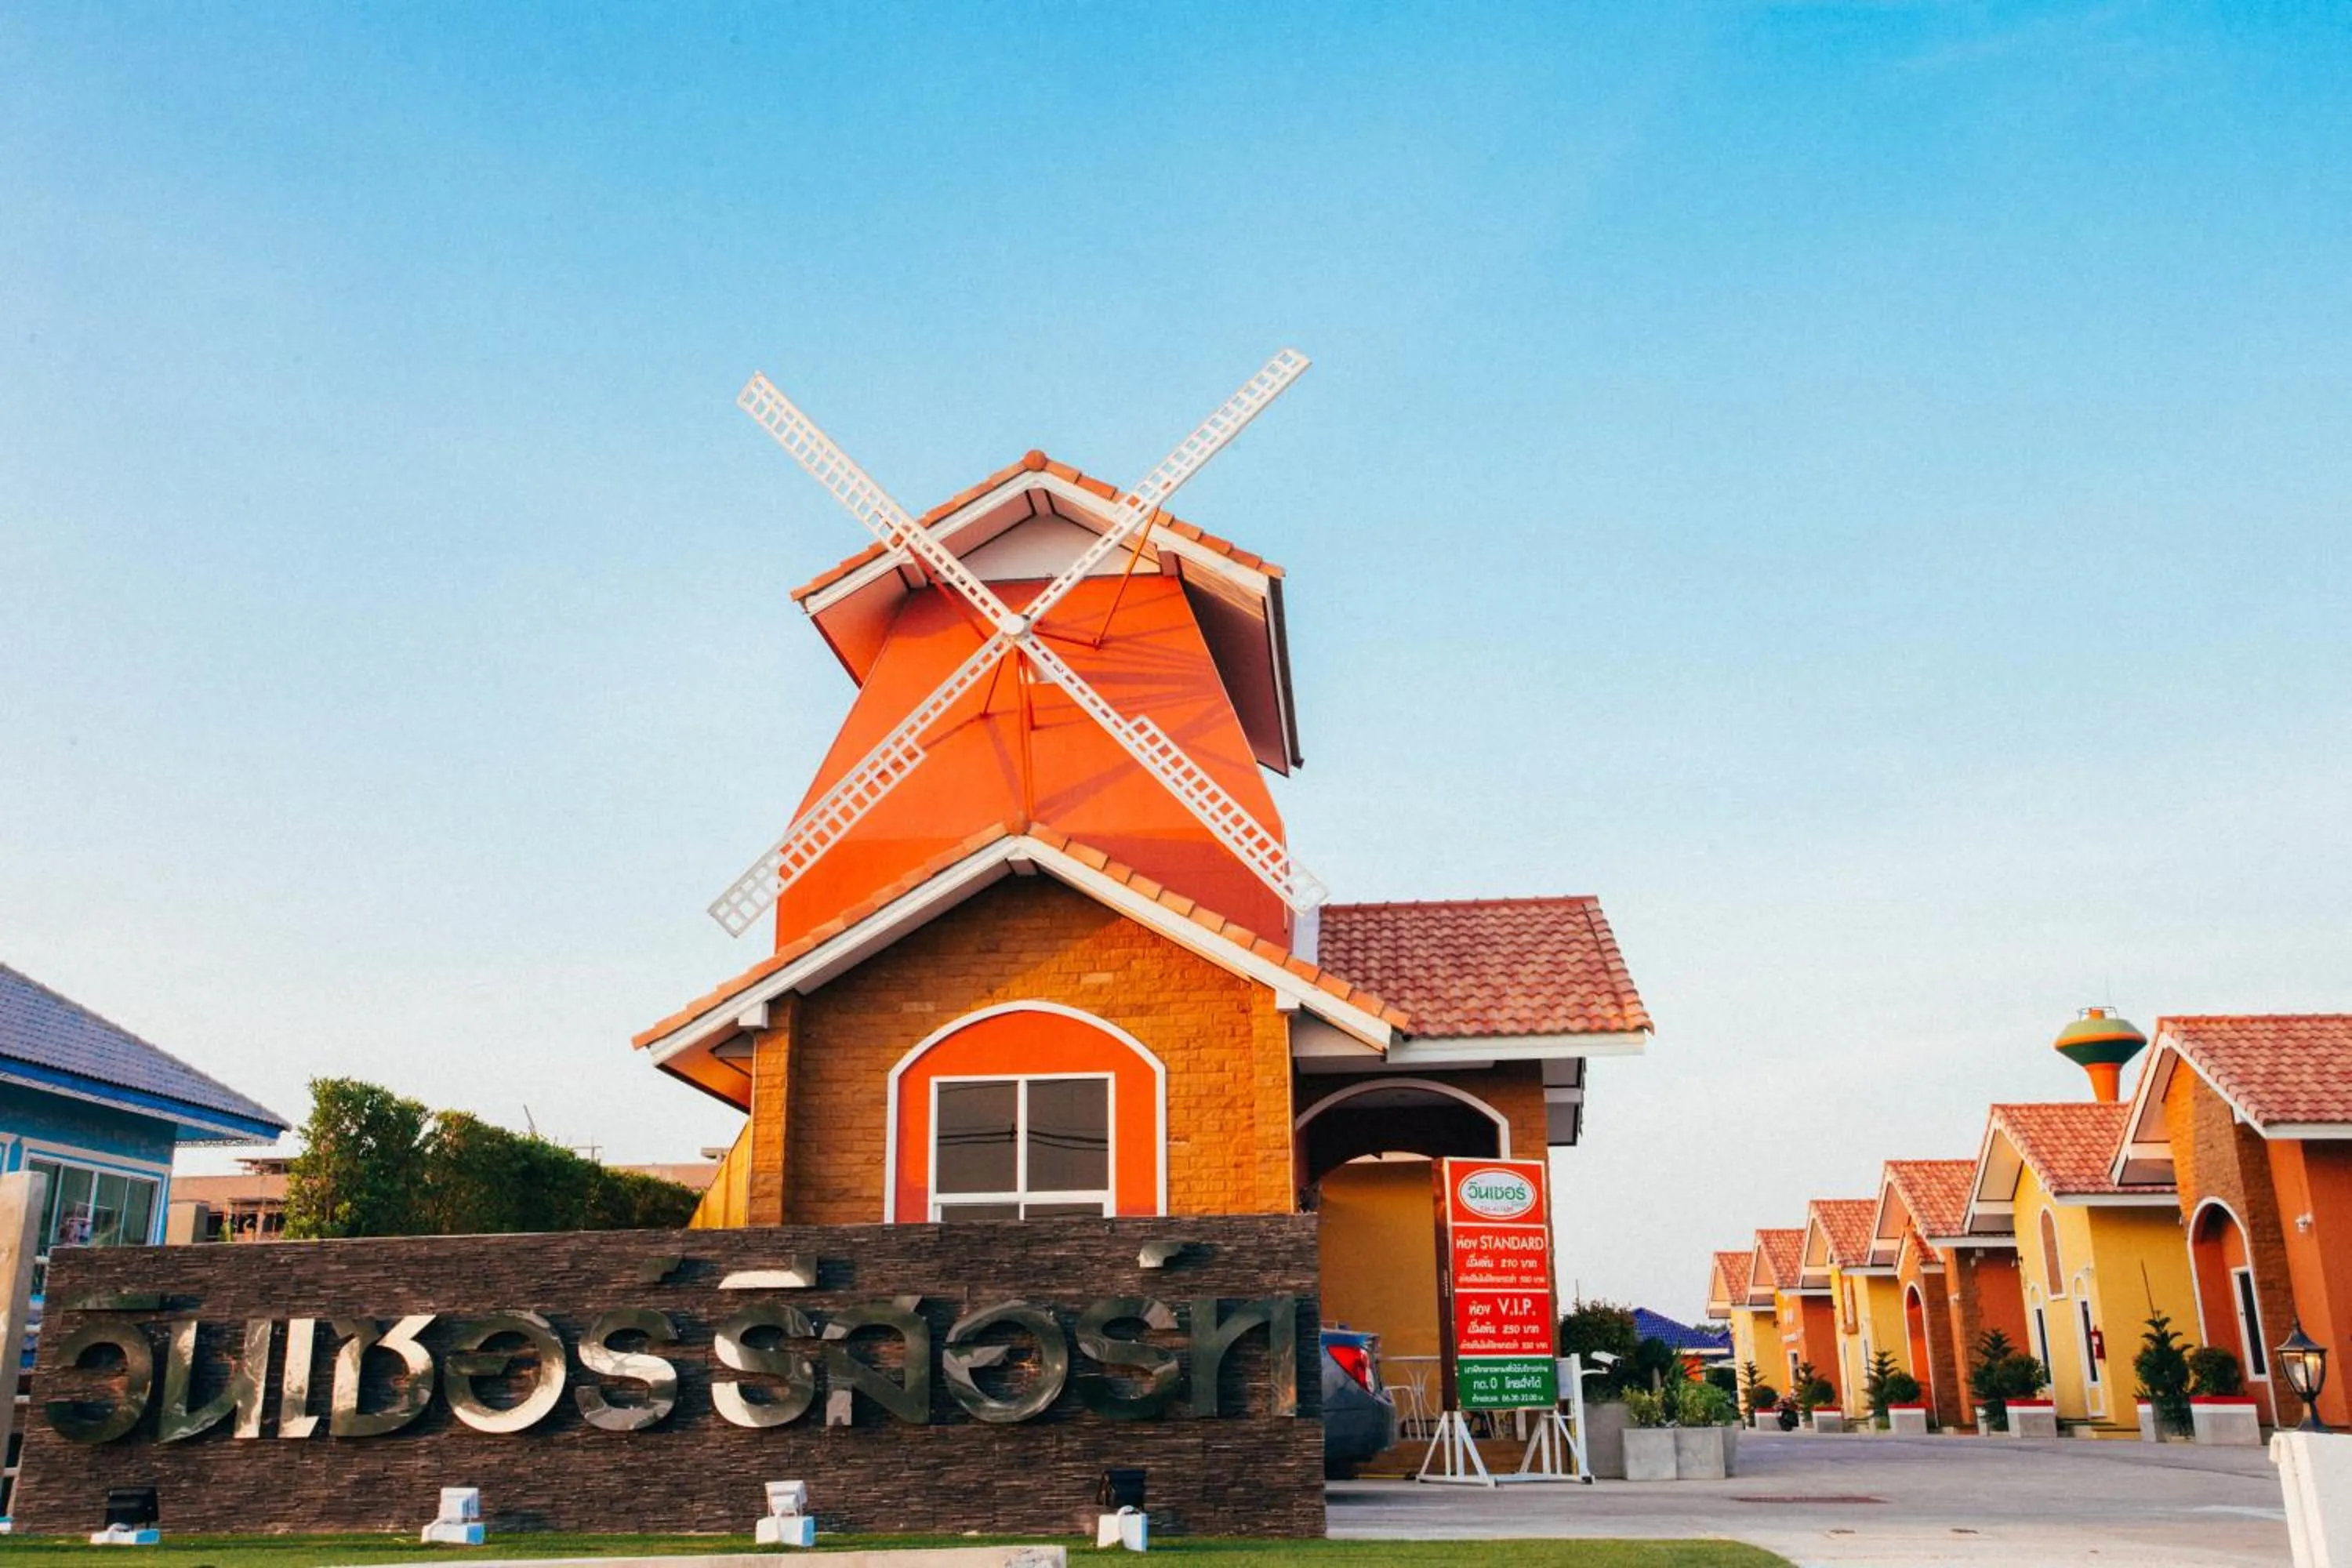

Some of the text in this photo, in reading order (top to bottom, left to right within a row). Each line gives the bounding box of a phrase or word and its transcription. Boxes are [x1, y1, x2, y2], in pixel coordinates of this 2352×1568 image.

[1479, 1235, 1544, 1251] STANDARD
[1468, 1298, 1537, 1316] ห้อง V.I.P.
